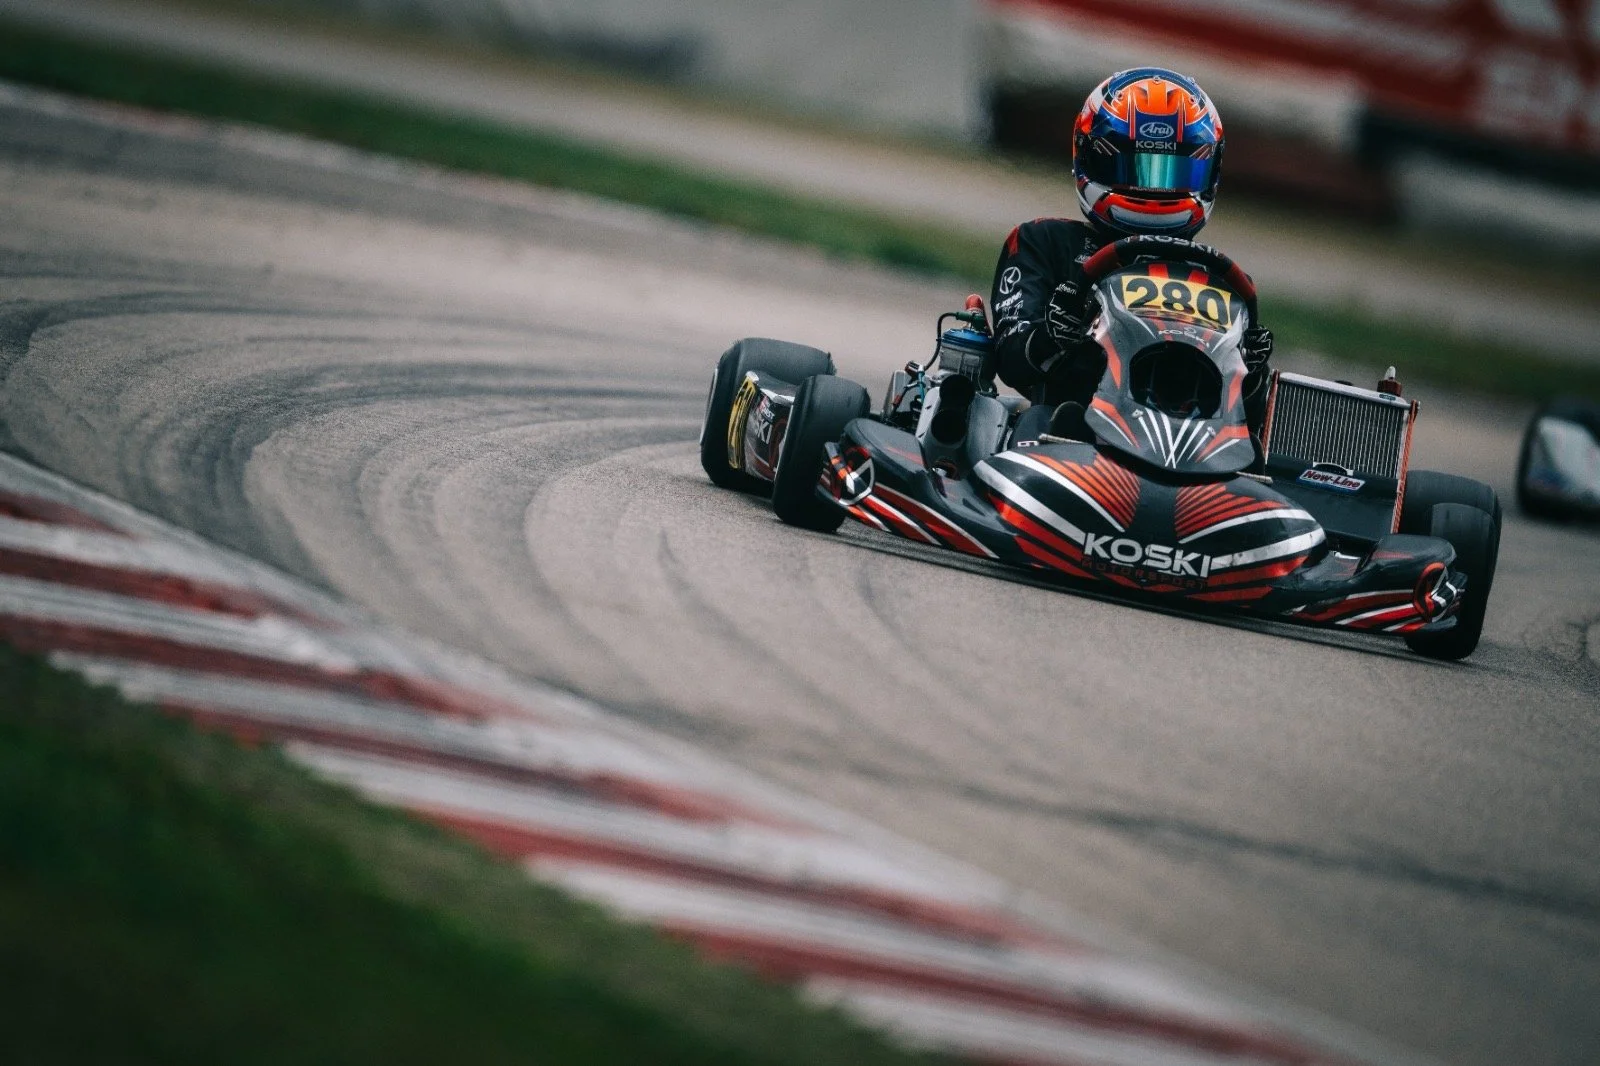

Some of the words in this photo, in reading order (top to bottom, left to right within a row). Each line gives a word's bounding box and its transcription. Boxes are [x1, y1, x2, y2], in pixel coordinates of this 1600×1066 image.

[1143, 122, 1169, 135] Arai
[1135, 140, 1177, 151] KOSKI
[1138, 234, 1212, 254] KOSKI
[1125, 277, 1229, 326] 280
[1303, 469, 1361, 490] New-Line
[1083, 532, 1212, 578] KOSKI
